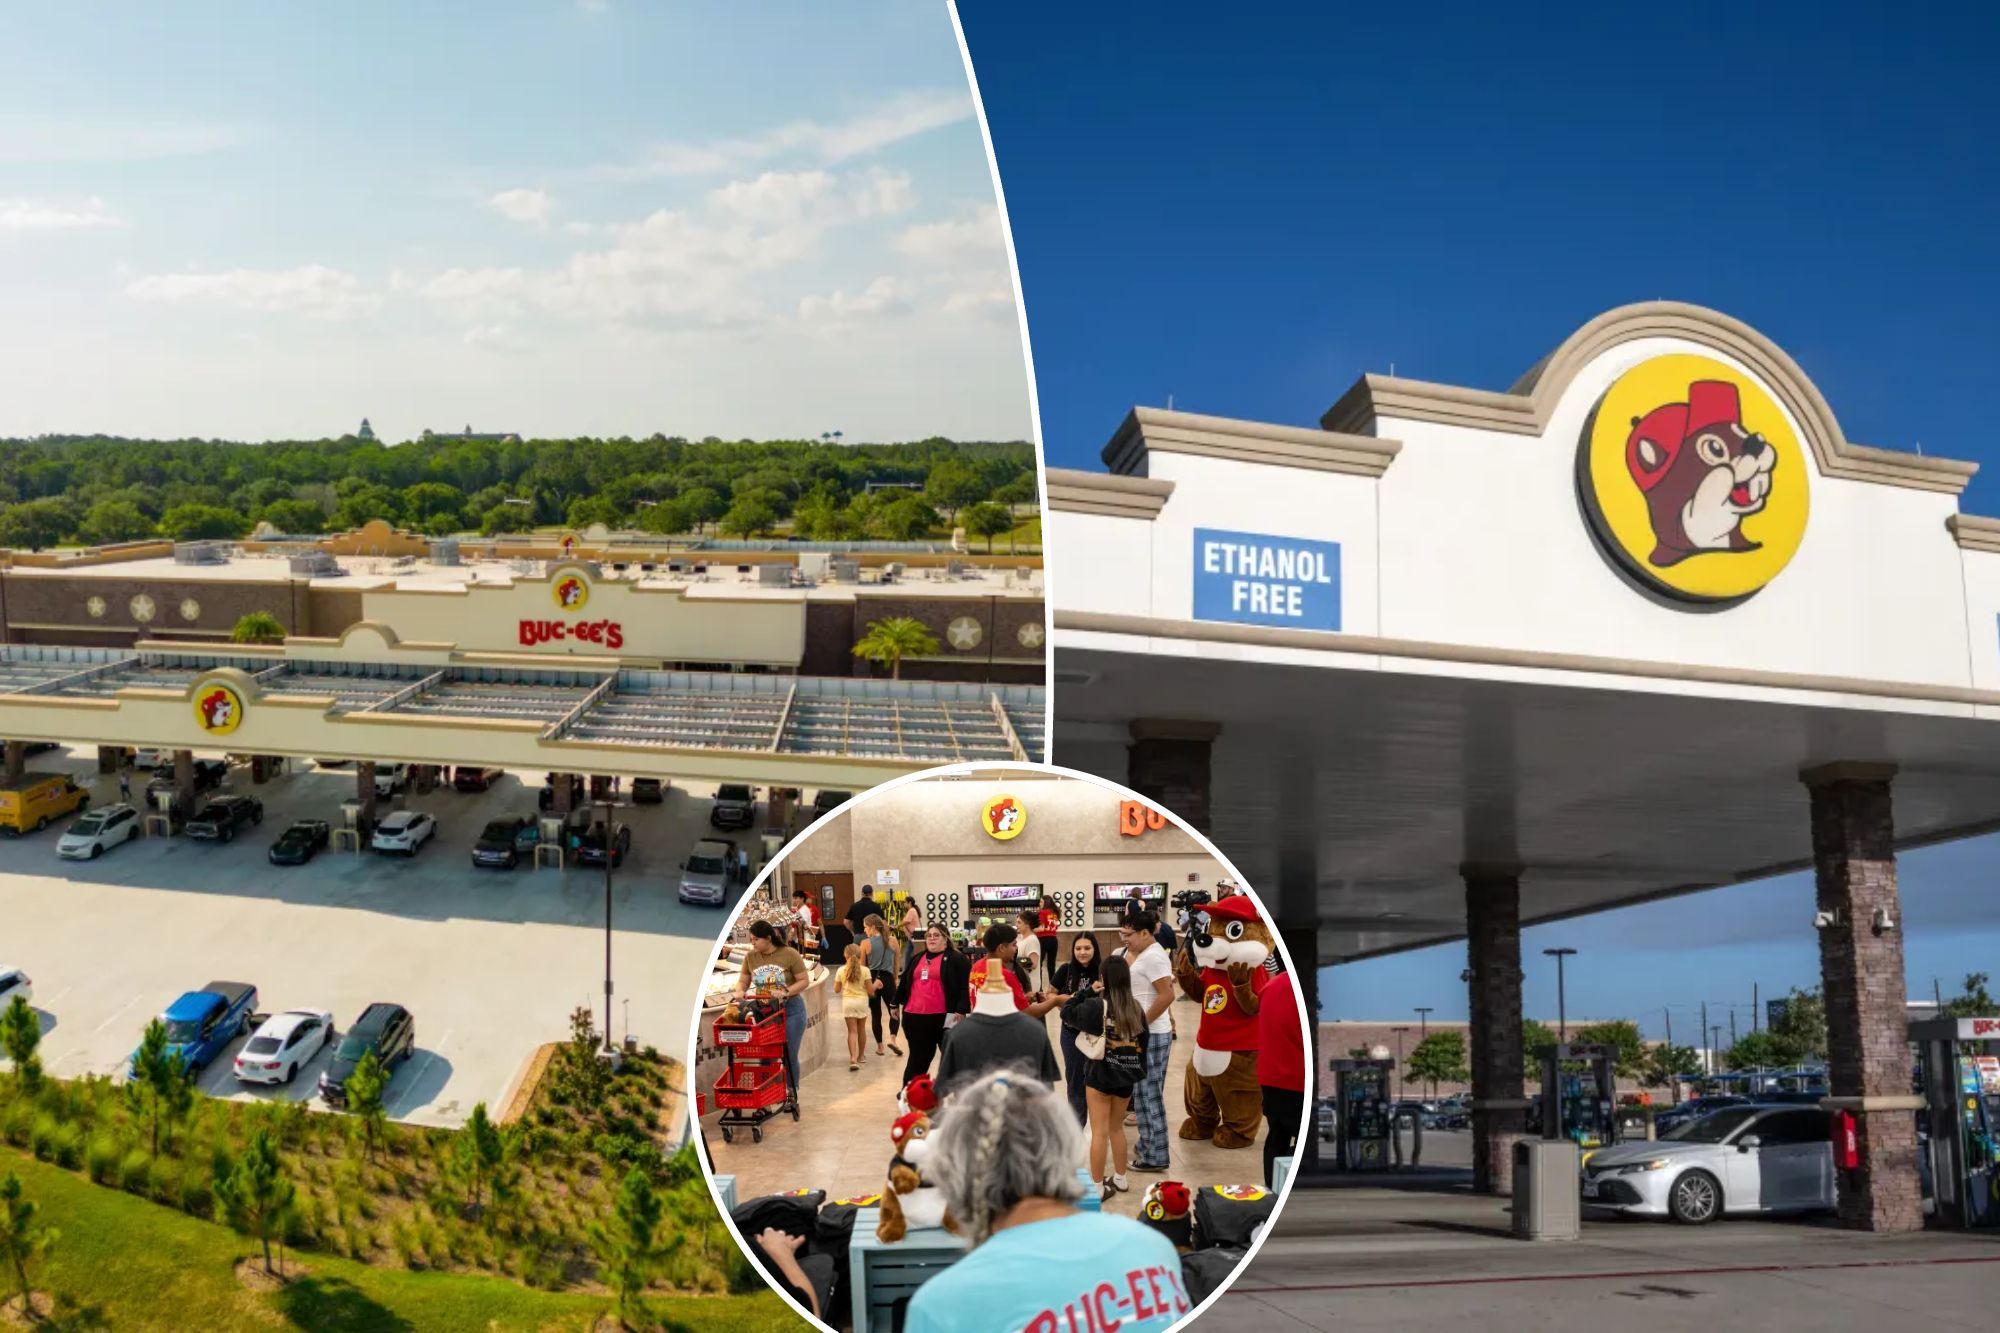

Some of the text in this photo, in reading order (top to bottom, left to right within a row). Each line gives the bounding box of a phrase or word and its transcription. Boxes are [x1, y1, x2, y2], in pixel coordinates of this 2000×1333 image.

[1204, 541, 1331, 584] ETHANOL
[1232, 580, 1303, 617] FREE
[1120, 800, 1178, 836] BU
